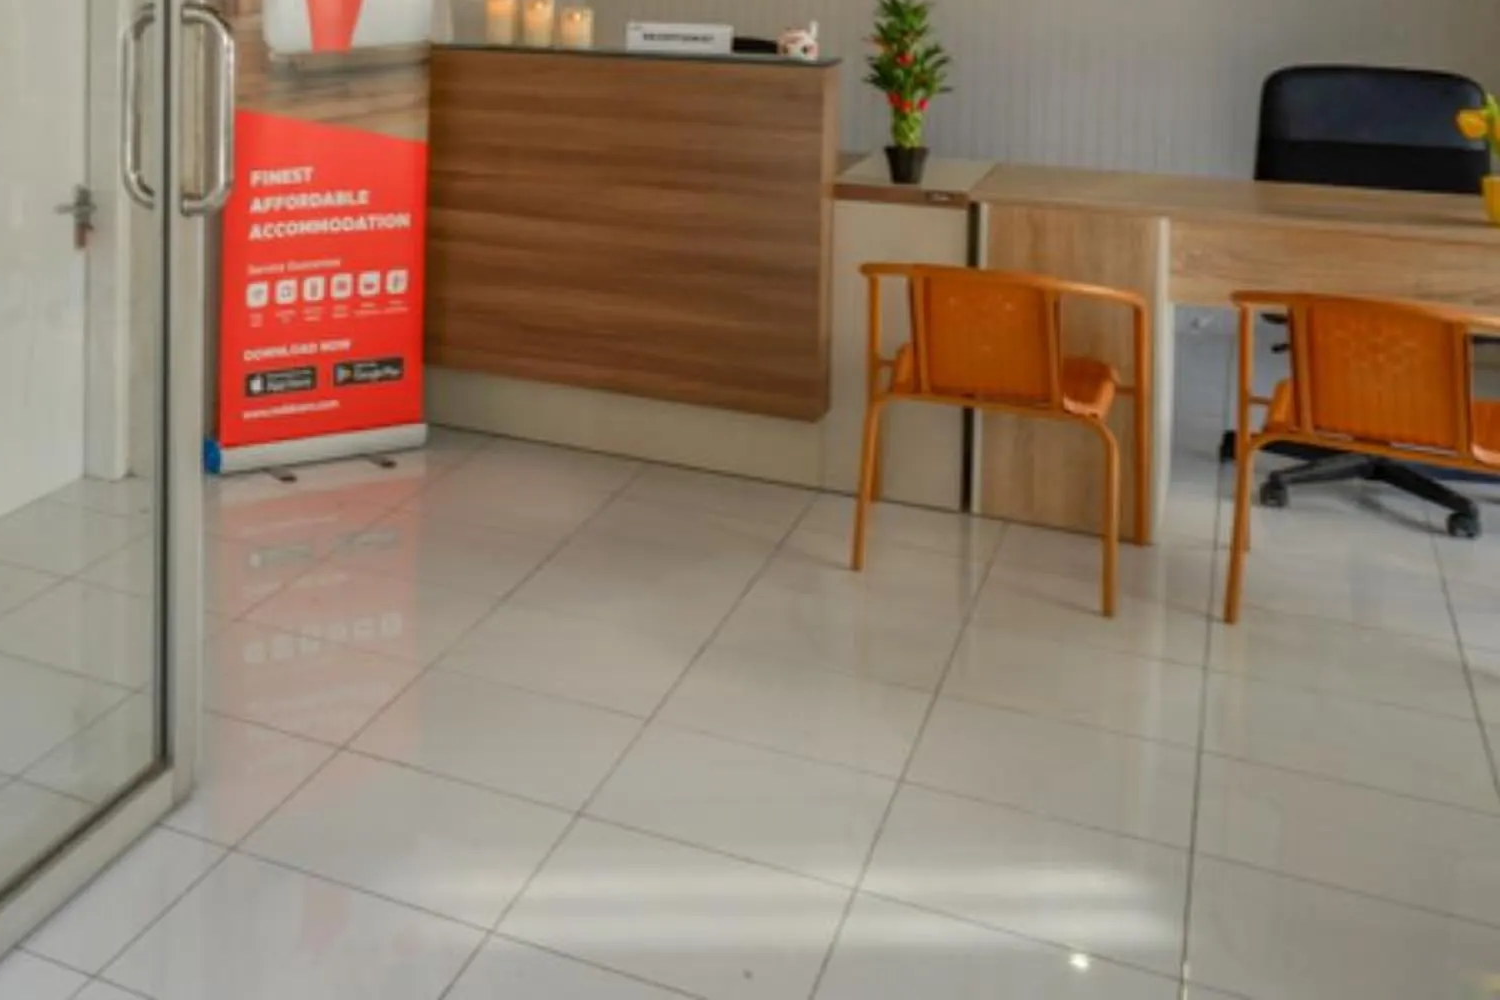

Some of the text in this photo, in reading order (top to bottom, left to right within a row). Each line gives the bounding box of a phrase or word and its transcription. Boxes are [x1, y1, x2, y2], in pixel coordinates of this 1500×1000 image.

[251, 166, 313, 187] FINEST
[249, 190, 368, 213] AFFORDABLE
[248, 213, 411, 240] ACCOMMODATION
[243, 339, 352, 361] DOWNLOAD NOW
